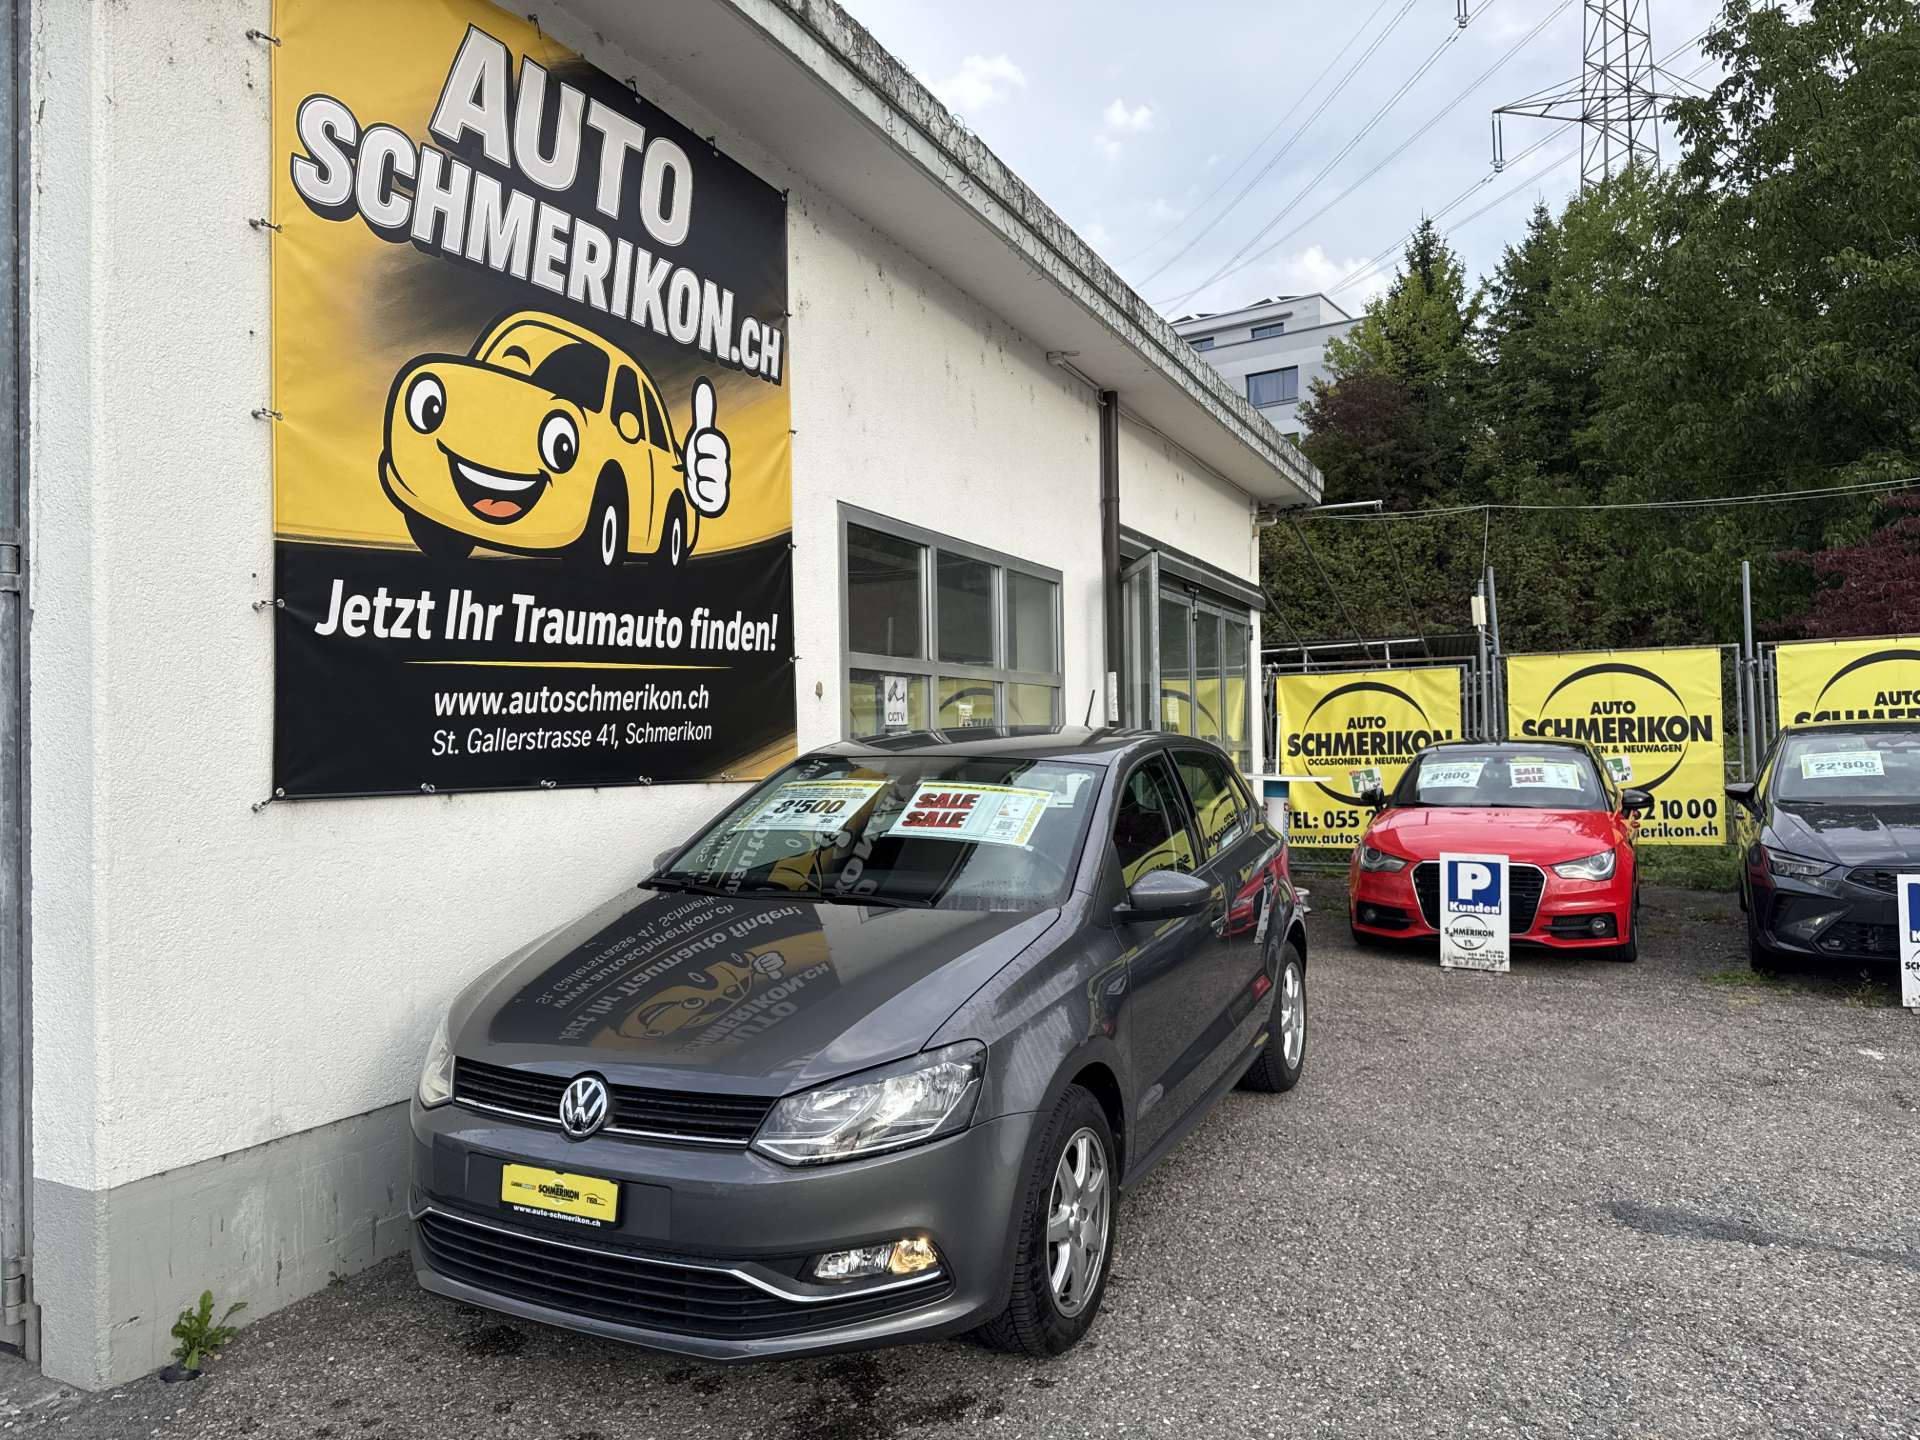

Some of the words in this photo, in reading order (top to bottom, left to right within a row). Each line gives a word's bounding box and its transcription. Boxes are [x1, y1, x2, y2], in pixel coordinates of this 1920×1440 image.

[432, 24, 694, 248] AUTO
[293, 96, 783, 382] SCHMERIKON.CH
[314, 579, 437, 641] Jetzt
[444, 587, 504, 643] Ihr
[511, 593, 684, 650] Traumauto
[689, 608, 778, 652] finden!
[433, 683, 709, 717] www.autoschmerikon.ch
[1591, 701, 1636, 715] AUTO
[887, 711, 905, 722] CCTV
[1347, 716, 1387, 730] AUTO
[431, 728, 460, 757] St.
[466, 726, 593, 753] Gallerstrasse
[596, 723, 620, 750] 41,
[625, 720, 712, 746] Schmerikon
[1611, 744, 1620, 753] &
[1623, 743, 1682, 753] NEUWAGEN
[1308, 757, 1362, 766] OCCASIONEN
[1364, 757, 1372, 765] &
[1374, 757, 1415, 765] NEUWAG
[773, 799, 847, 814] 8'500
[914, 792, 981, 809] SALE
[1660, 800, 1683, 820] 10
[1686, 798, 1718, 819] 00
[902, 810, 970, 828] SALE
[1323, 811, 1360, 829] 055
[1637, 821, 1719, 837] erikon.ch
[1457, 862, 1492, 900] P
[1449, 900, 1500, 914] Kunden
[538, 1184, 580, 1201] SCHMERIKON
[513, 1204, 601, 1227] www.auto-schmerikon.ch
